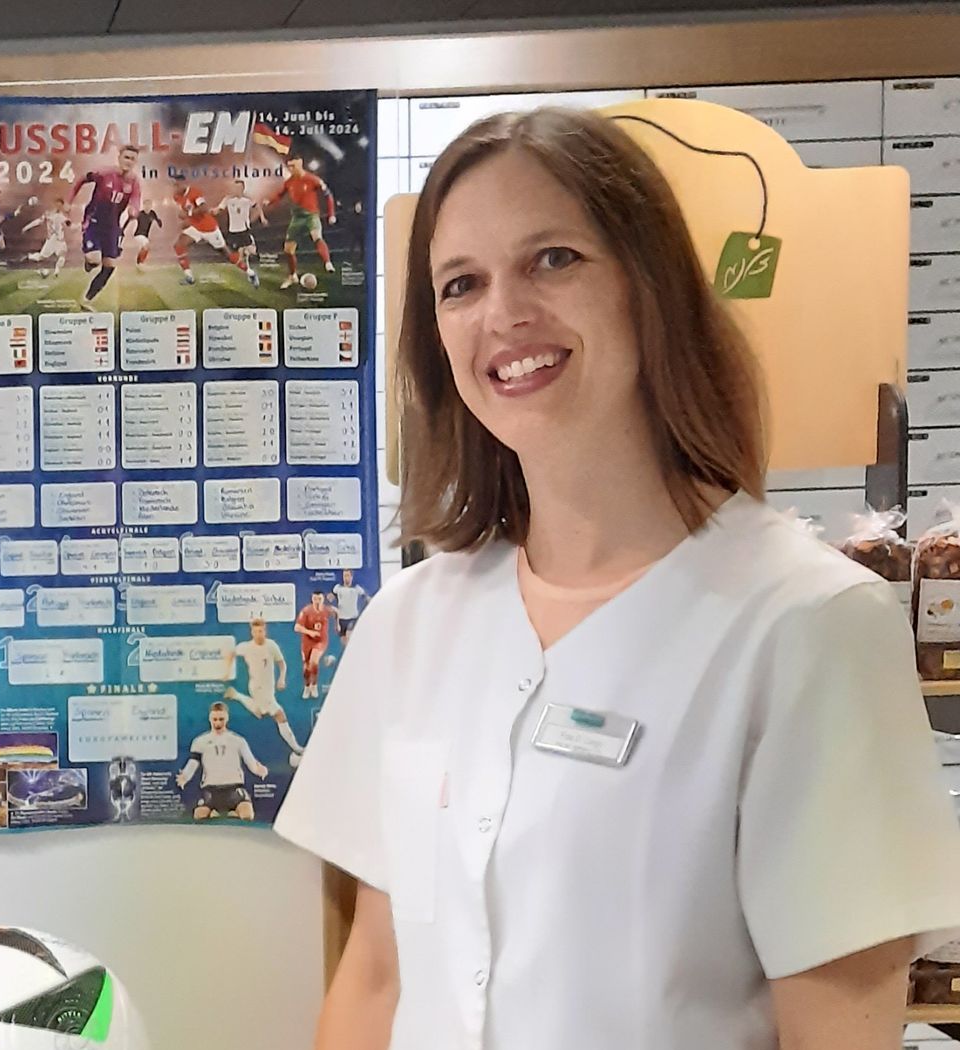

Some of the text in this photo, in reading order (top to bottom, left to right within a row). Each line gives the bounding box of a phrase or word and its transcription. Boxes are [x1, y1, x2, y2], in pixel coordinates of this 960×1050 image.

[315, 109, 335, 121] bis
[328, 124, 360, 135] 2024
[141, 165, 158, 179] in
[100, 684, 145, 694] FINALE
